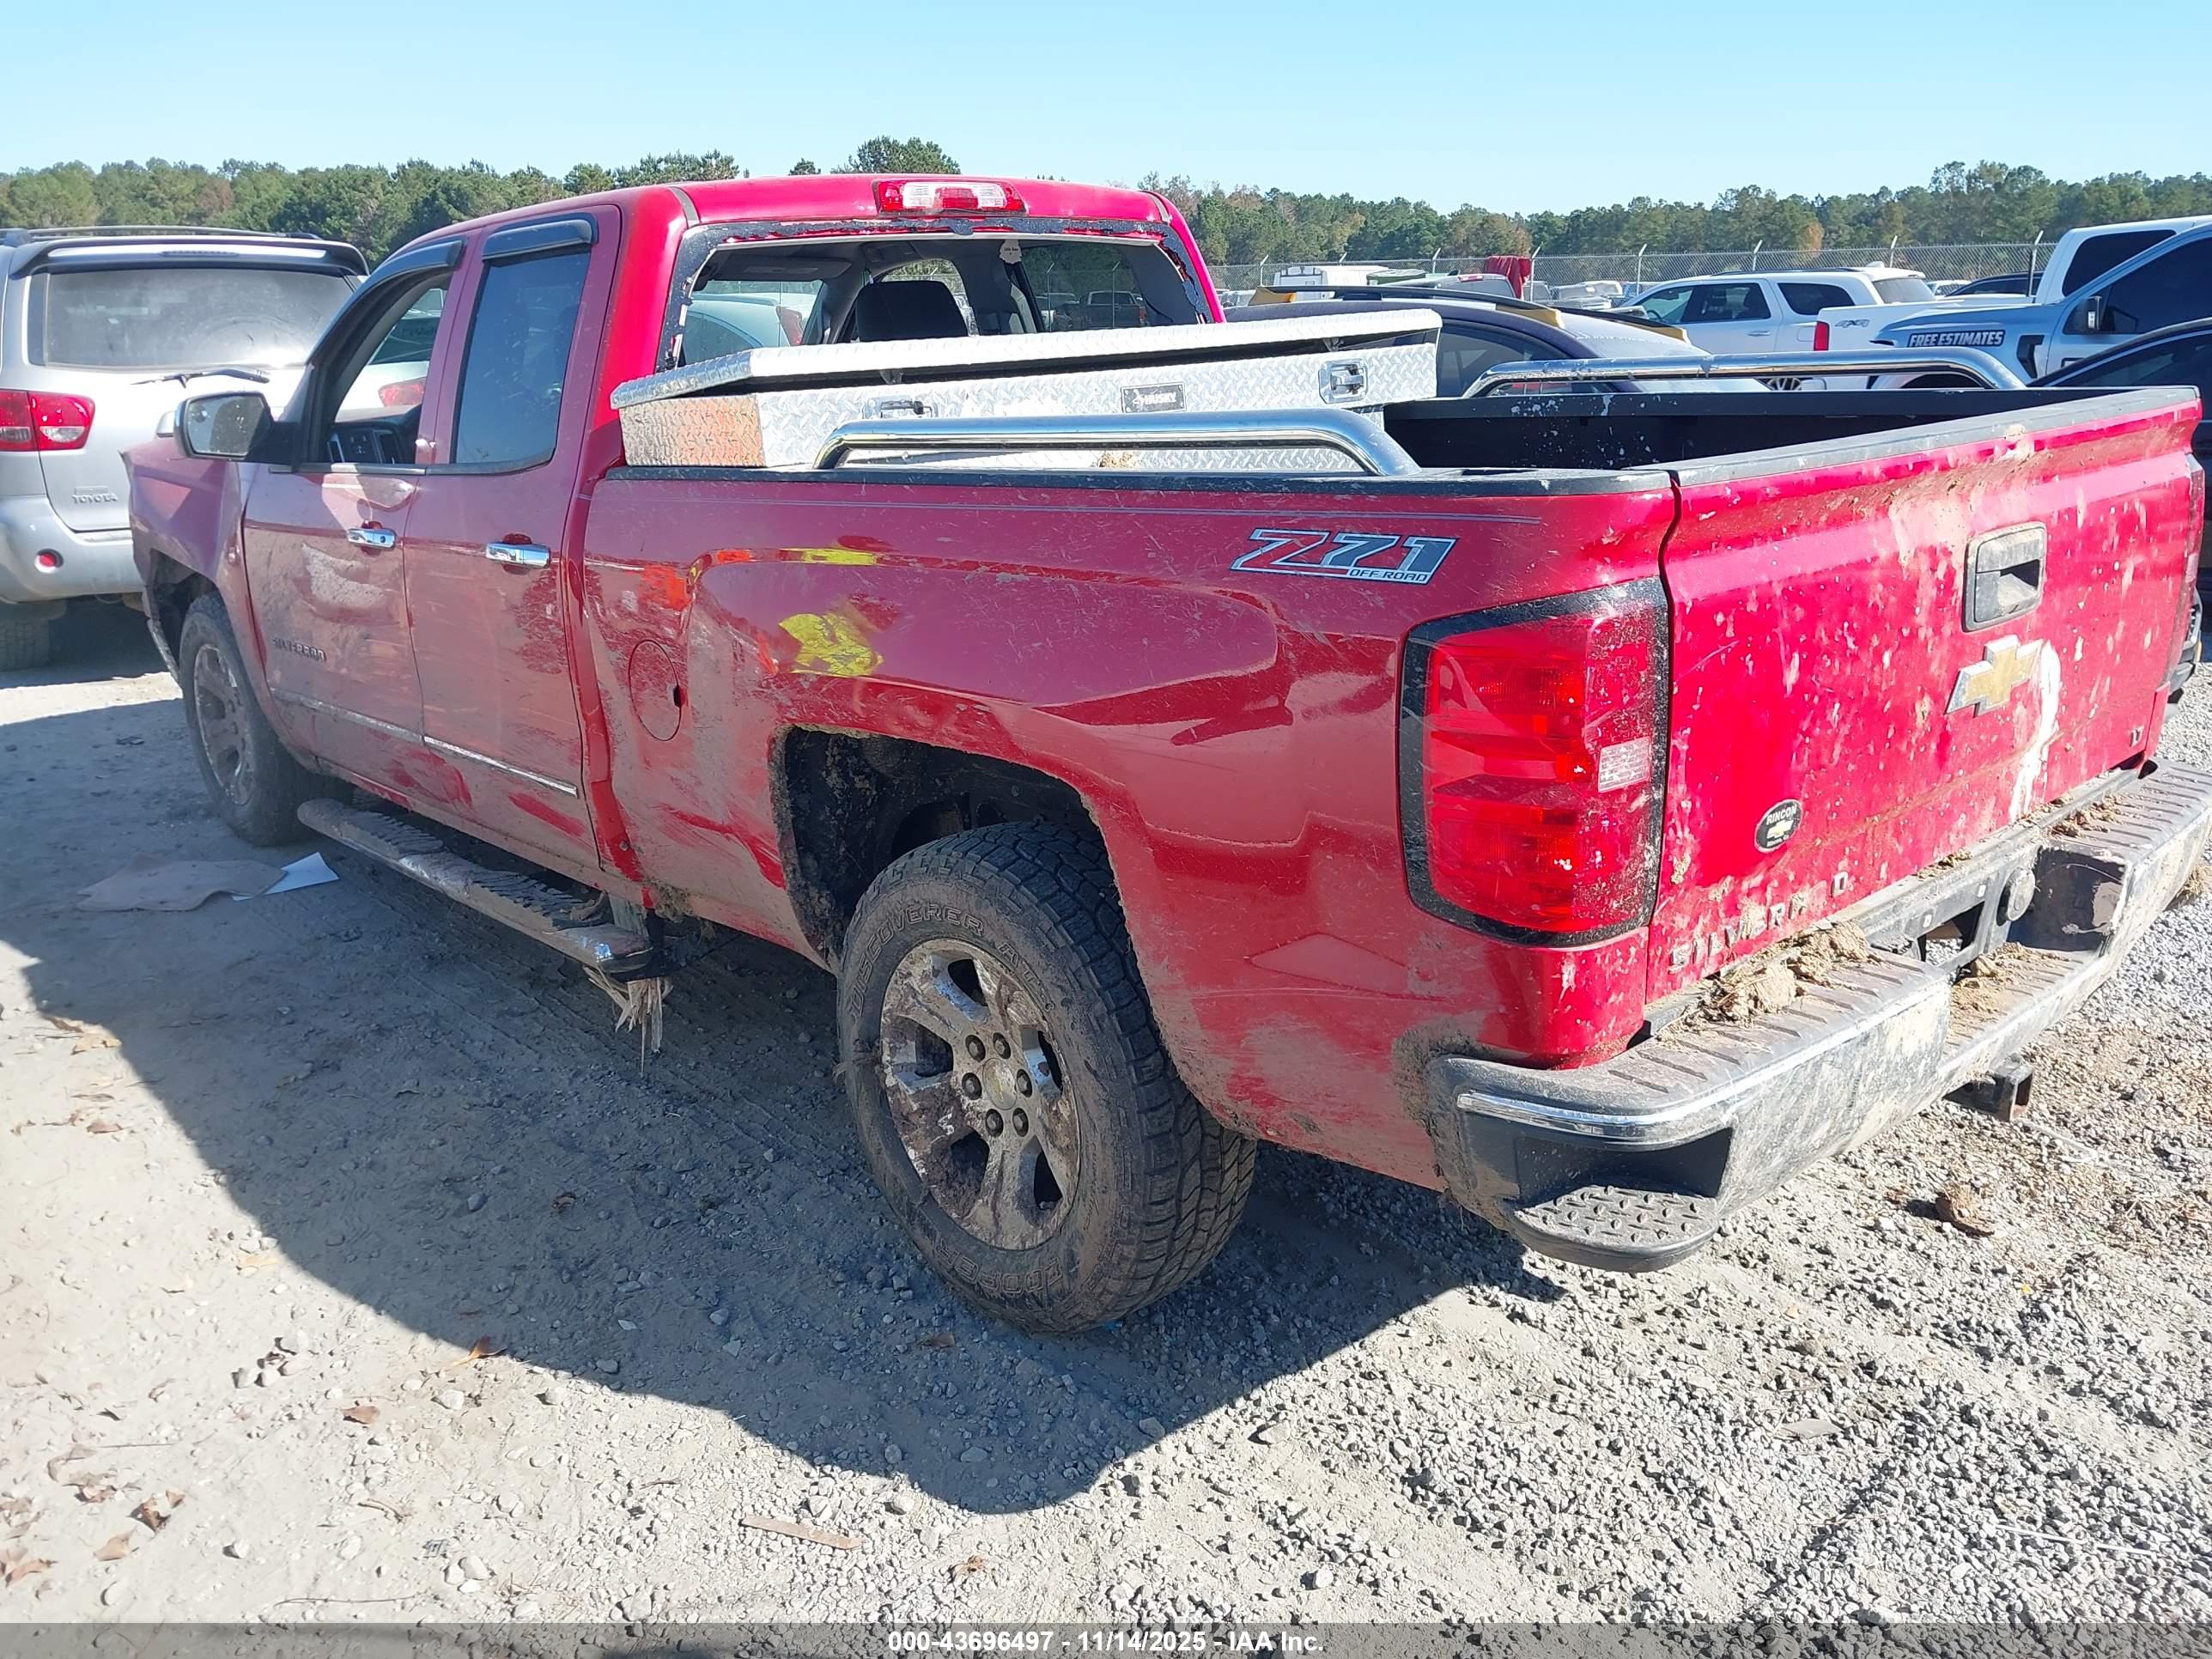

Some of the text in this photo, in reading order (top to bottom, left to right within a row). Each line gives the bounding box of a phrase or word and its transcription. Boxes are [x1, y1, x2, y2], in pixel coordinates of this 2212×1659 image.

[1909, 331, 2004, 347] FREE ESTIMATES
[70, 493, 119, 505] TOYOTA
[1230, 528, 1459, 585] Z71
[1349, 568, 1429, 582] OFF ROAD
[1766, 803, 1798, 826] RINCON
[850, 902, 985, 1018] DISCOVERER
[936, 1239, 1063, 1295] COOPER
